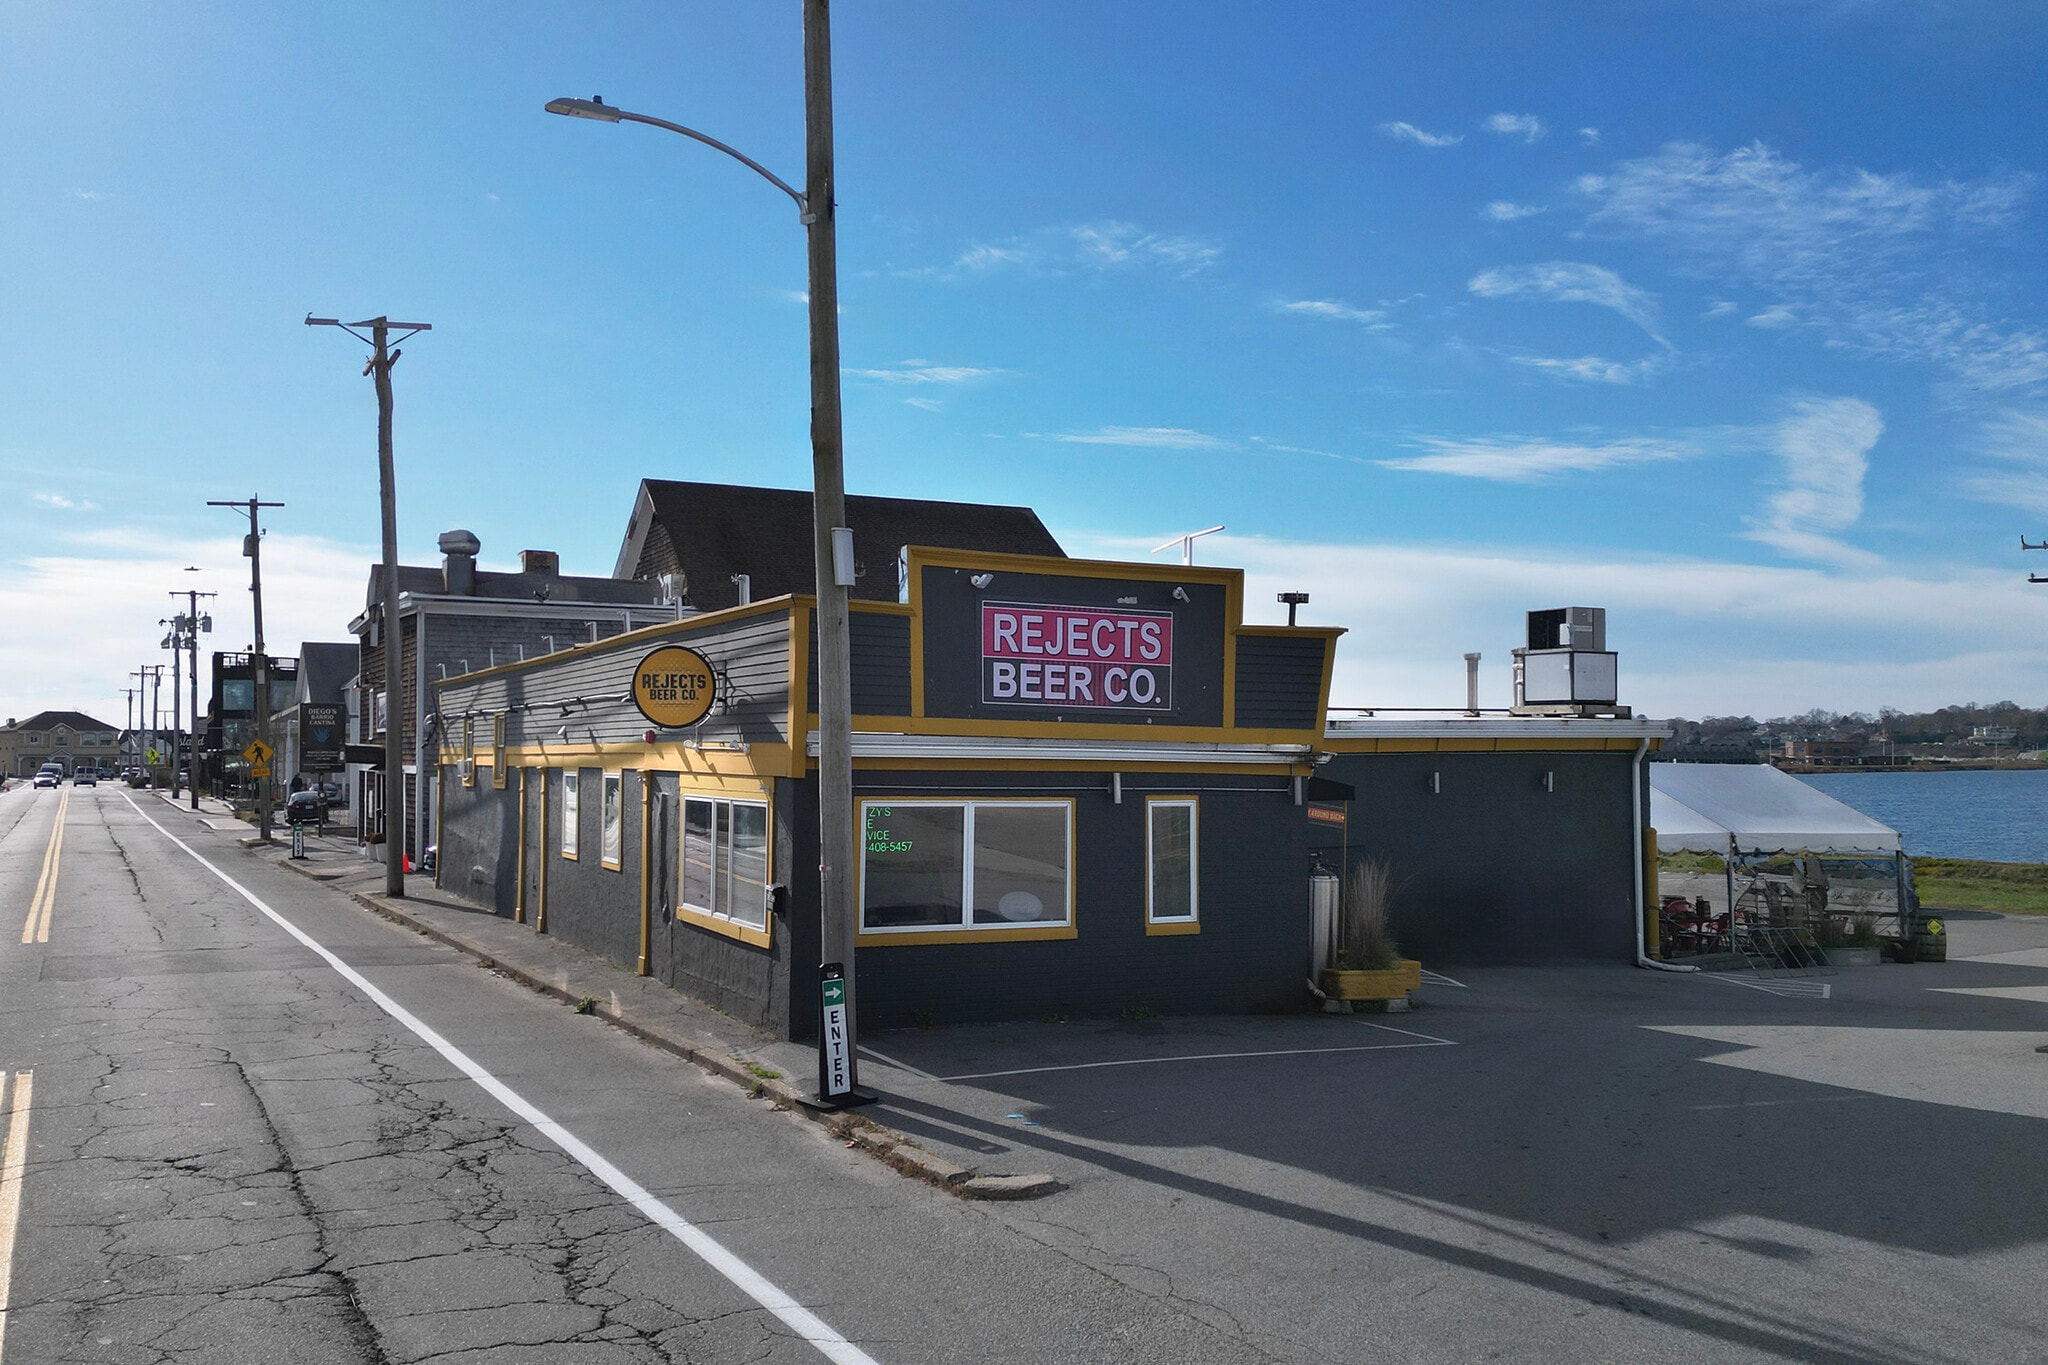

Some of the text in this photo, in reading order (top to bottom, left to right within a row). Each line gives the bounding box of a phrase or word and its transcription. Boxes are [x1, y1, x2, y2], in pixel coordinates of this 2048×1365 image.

[993, 613, 1162, 660] REJECTS
[642, 674, 707, 689] REJECTS
[649, 689, 699, 700] BEER CO.
[992, 661, 1162, 704] BEER CO.
[308, 707, 337, 715] DIEGO'S
[830, 1010, 843, 1088] ENTER
